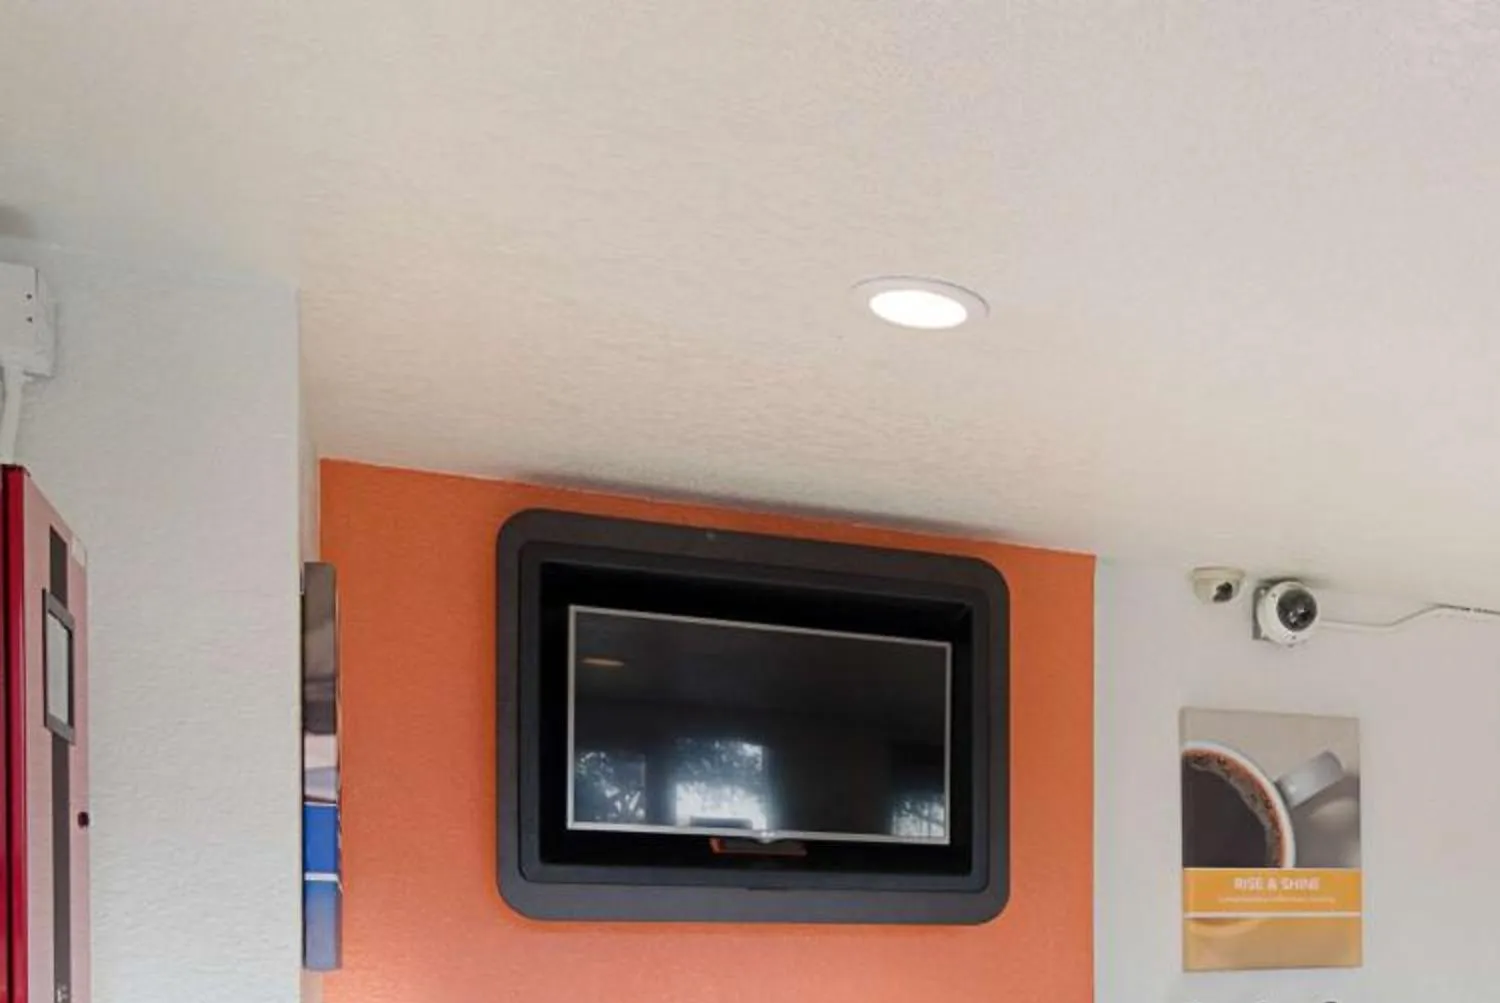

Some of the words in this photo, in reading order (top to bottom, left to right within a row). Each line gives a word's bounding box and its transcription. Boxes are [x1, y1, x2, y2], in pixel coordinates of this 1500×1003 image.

[1234, 877, 1263, 890] RISE
[1267, 877, 1277, 890] &
[1280, 877, 1319, 890] SHINE
